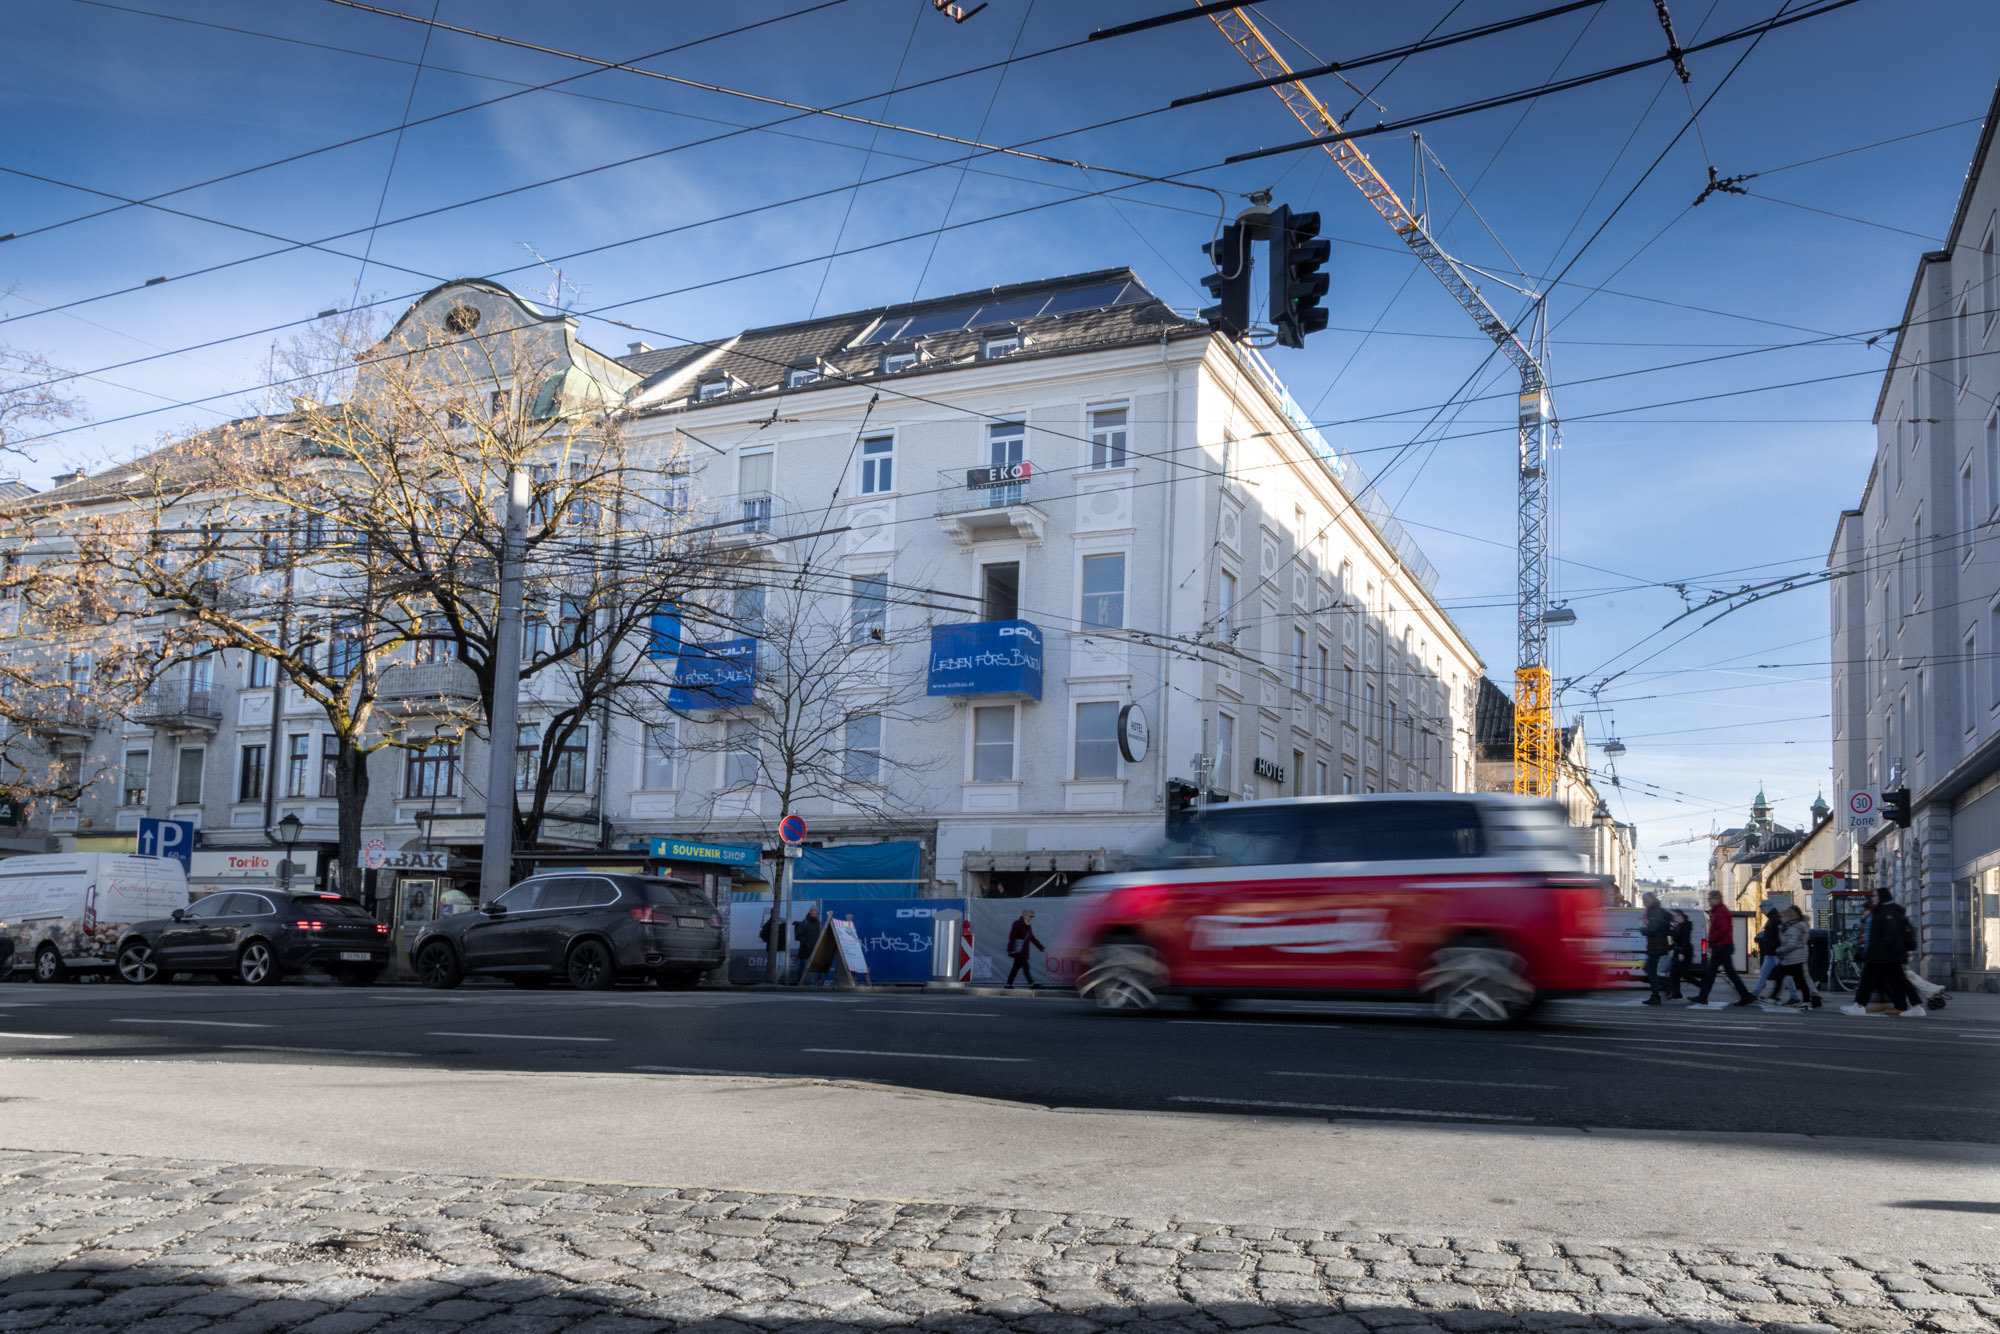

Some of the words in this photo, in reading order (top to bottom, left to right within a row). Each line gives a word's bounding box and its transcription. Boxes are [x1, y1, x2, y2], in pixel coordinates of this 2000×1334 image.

[989, 465, 1023, 481] EKO
[999, 627, 1040, 644] DOLL
[931, 652, 973, 672] LEBEN
[1130, 721, 1144, 735] HOTEL
[1258, 758, 1288, 783] HOTEL
[1855, 798, 1868, 809] 30
[1850, 816, 1874, 827] Zone
[156, 821, 184, 857] P
[672, 844, 721, 859] SOUVENIR
[722, 850, 746, 861] SHOP
[228, 855, 270, 868] Toriko
